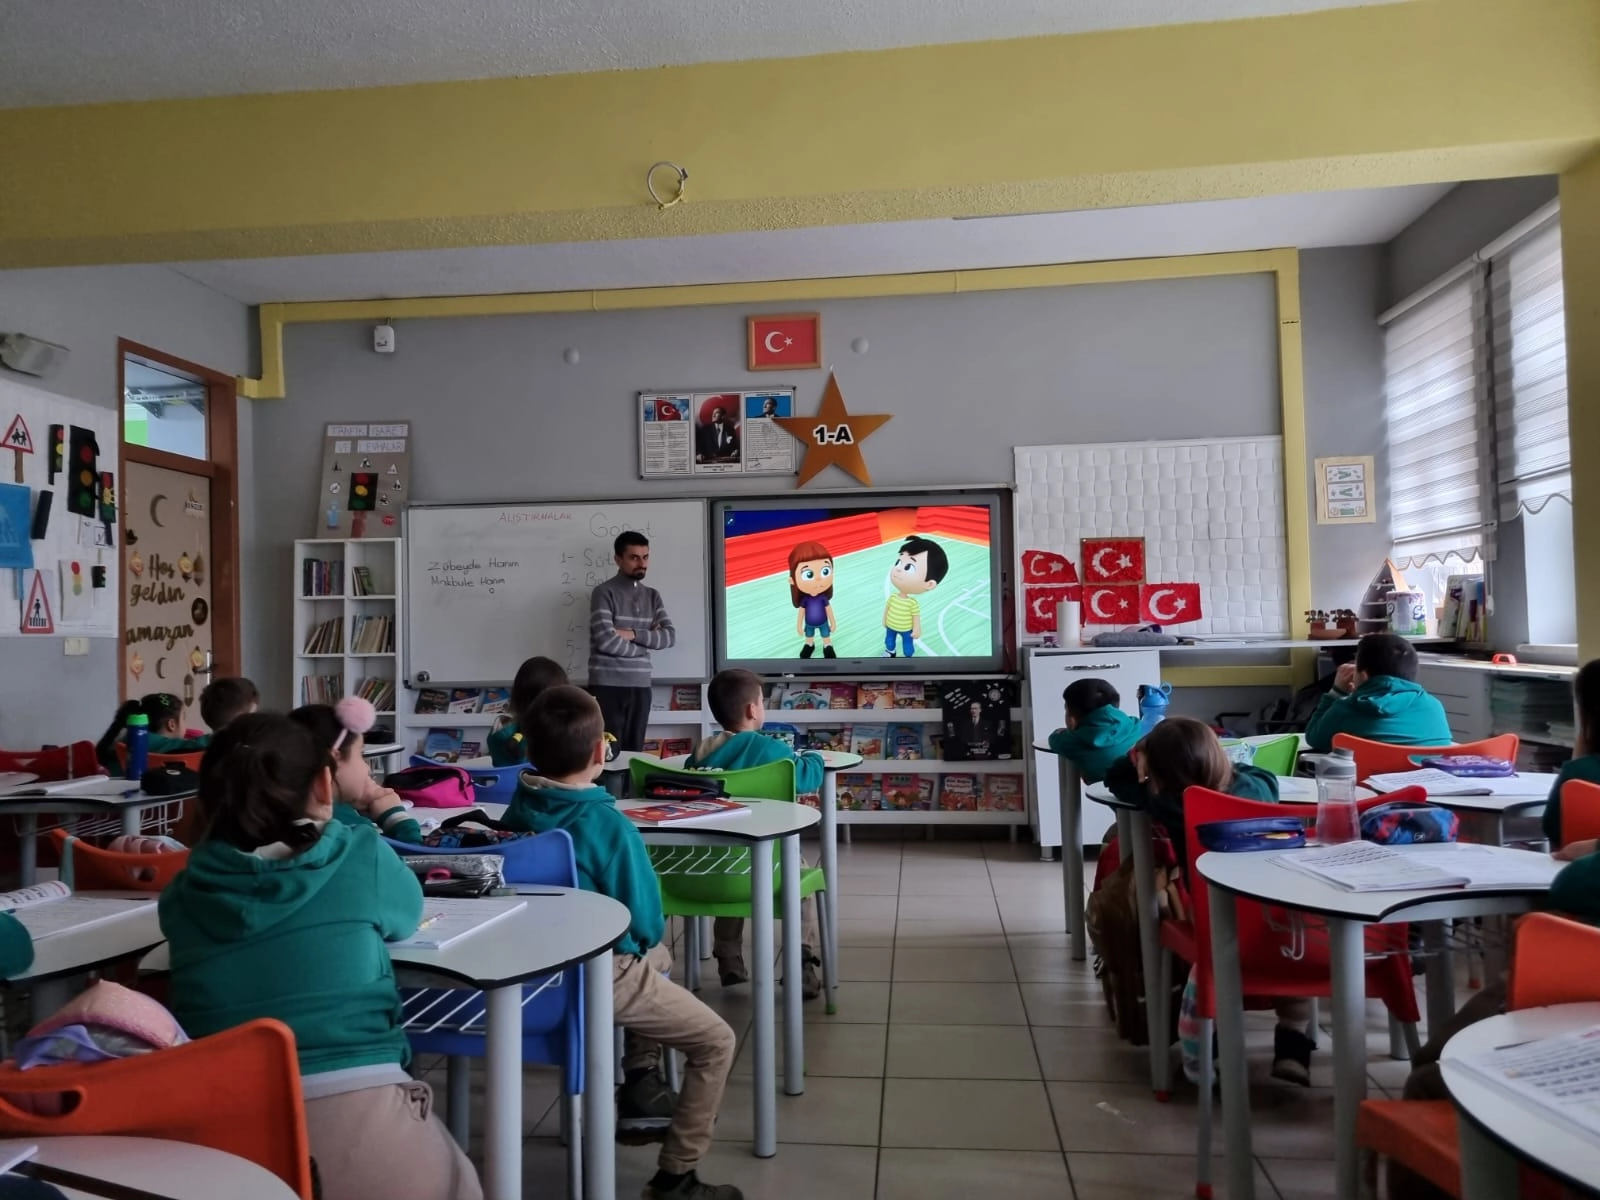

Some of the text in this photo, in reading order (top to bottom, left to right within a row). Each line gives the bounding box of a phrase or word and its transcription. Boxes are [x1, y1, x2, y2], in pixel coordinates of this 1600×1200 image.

[814, 425, 853, 444] 1-A
[427, 559, 481, 575] Zübeyde
[431, 575, 475, 588] Makbule
[126, 624, 194, 651] amazan
